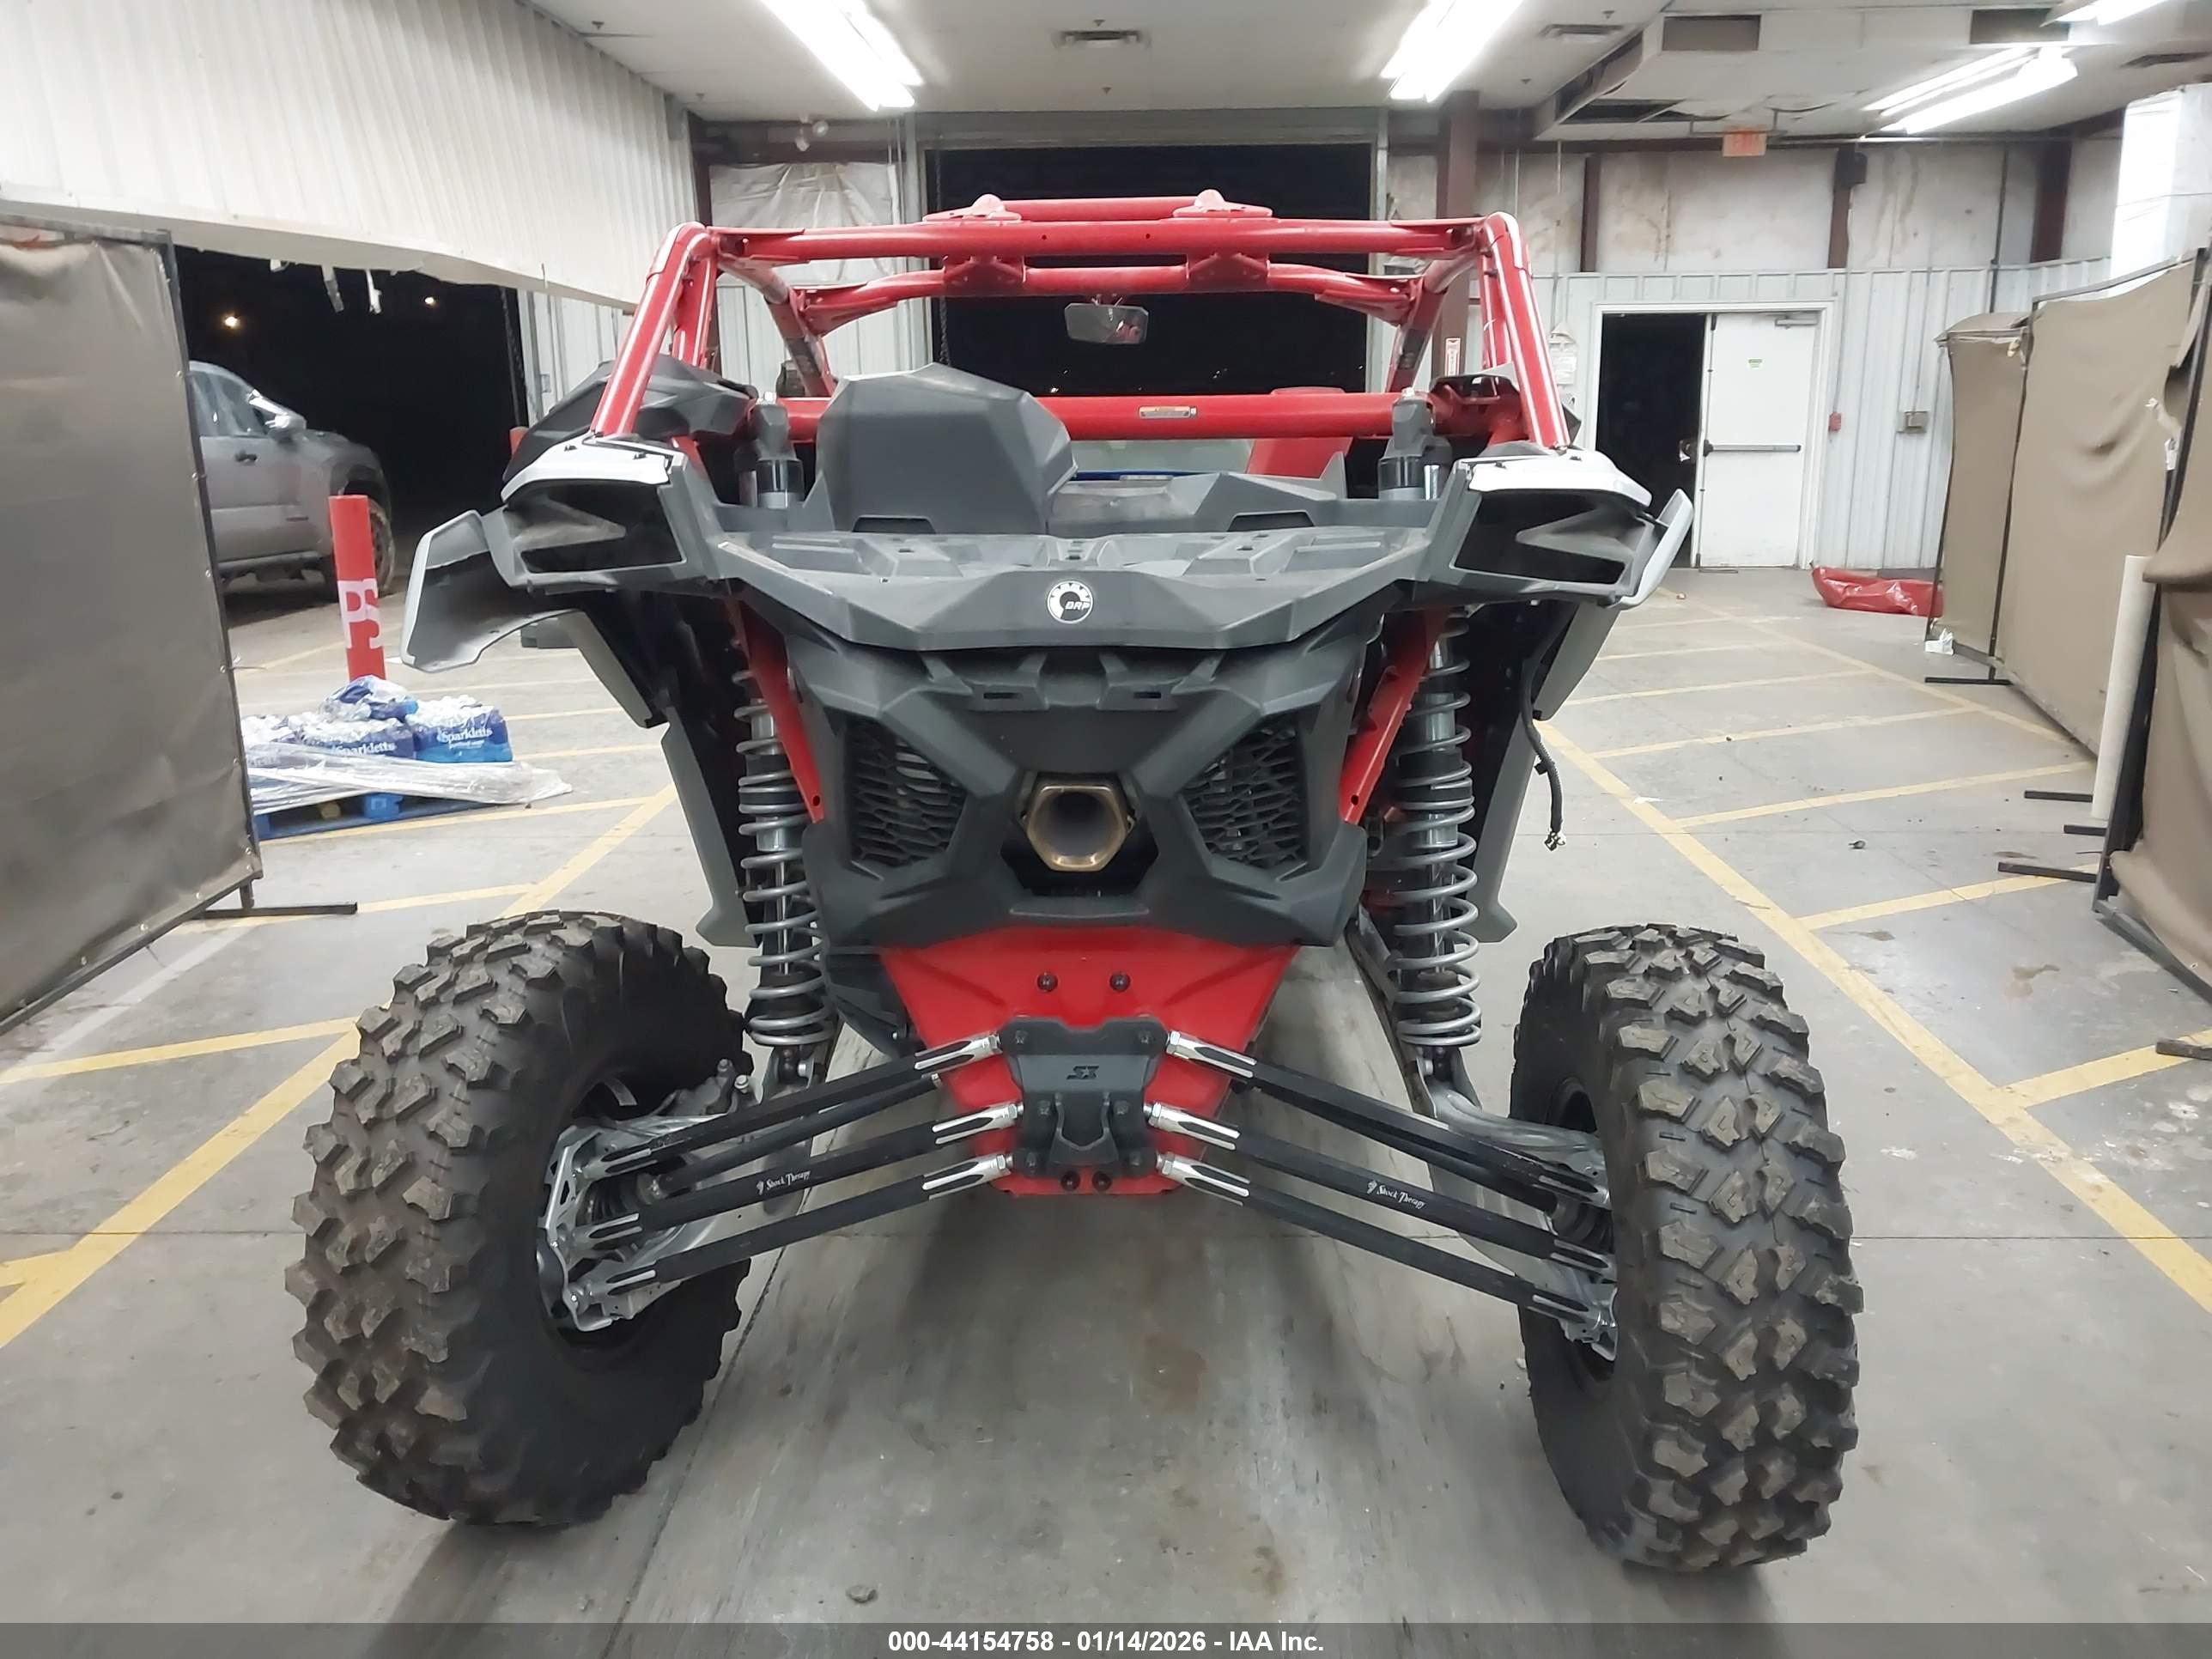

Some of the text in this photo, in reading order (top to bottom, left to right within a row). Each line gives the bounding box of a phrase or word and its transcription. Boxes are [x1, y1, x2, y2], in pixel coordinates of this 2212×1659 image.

[442, 726, 494, 744] Sparkletts
[766, 1170, 811, 1191] Shock Therapy
[1376, 1185, 1426, 1210] Shock Therapy
